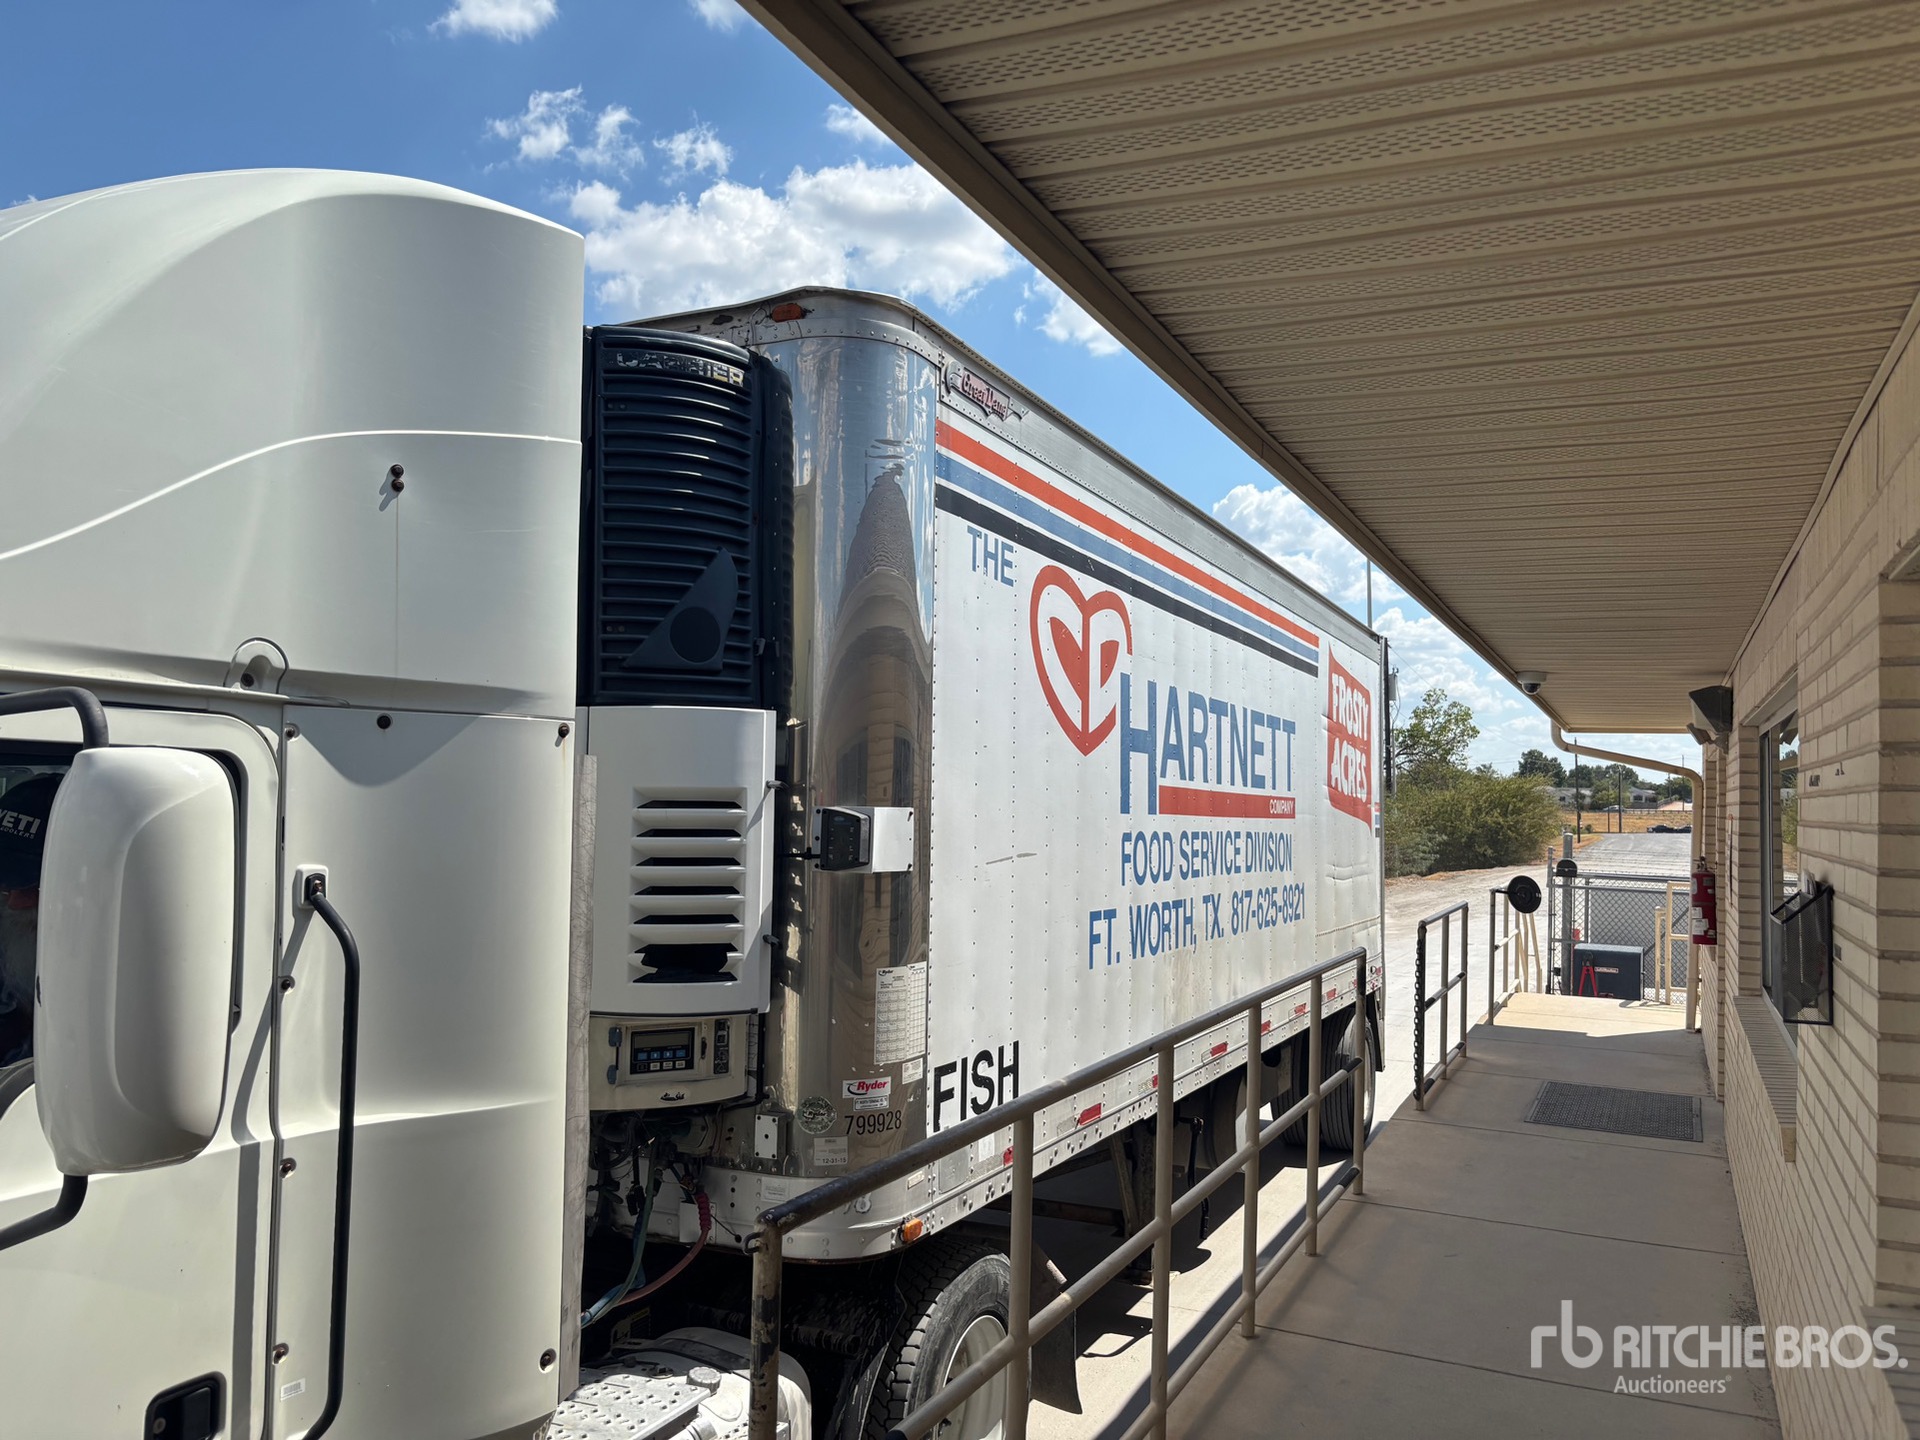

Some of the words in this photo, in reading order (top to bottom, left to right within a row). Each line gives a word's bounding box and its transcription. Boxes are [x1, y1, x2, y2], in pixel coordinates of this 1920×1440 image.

[967, 525, 1015, 587] THE
[1331, 672, 1370, 742] FROSTY
[1120, 672, 1296, 815] HARTNETT
[1330, 737, 1368, 803] ACRES
[1269, 798, 1294, 815] COMPANY
[1121, 830, 1173, 886] FOOD
[1179, 830, 1241, 880] SERVICE
[1245, 830, 1292, 872] DIVISION
[1089, 908, 1120, 970] FT.
[1129, 897, 1197, 960] WORTH,
[1202, 893, 1224, 941] TX.
[1231, 882, 1306, 936] 817-625-8921
[857, 1080, 888, 1092] Ryder
[933, 1040, 1020, 1133] FISH
[844, 1110, 902, 1136] 799928
